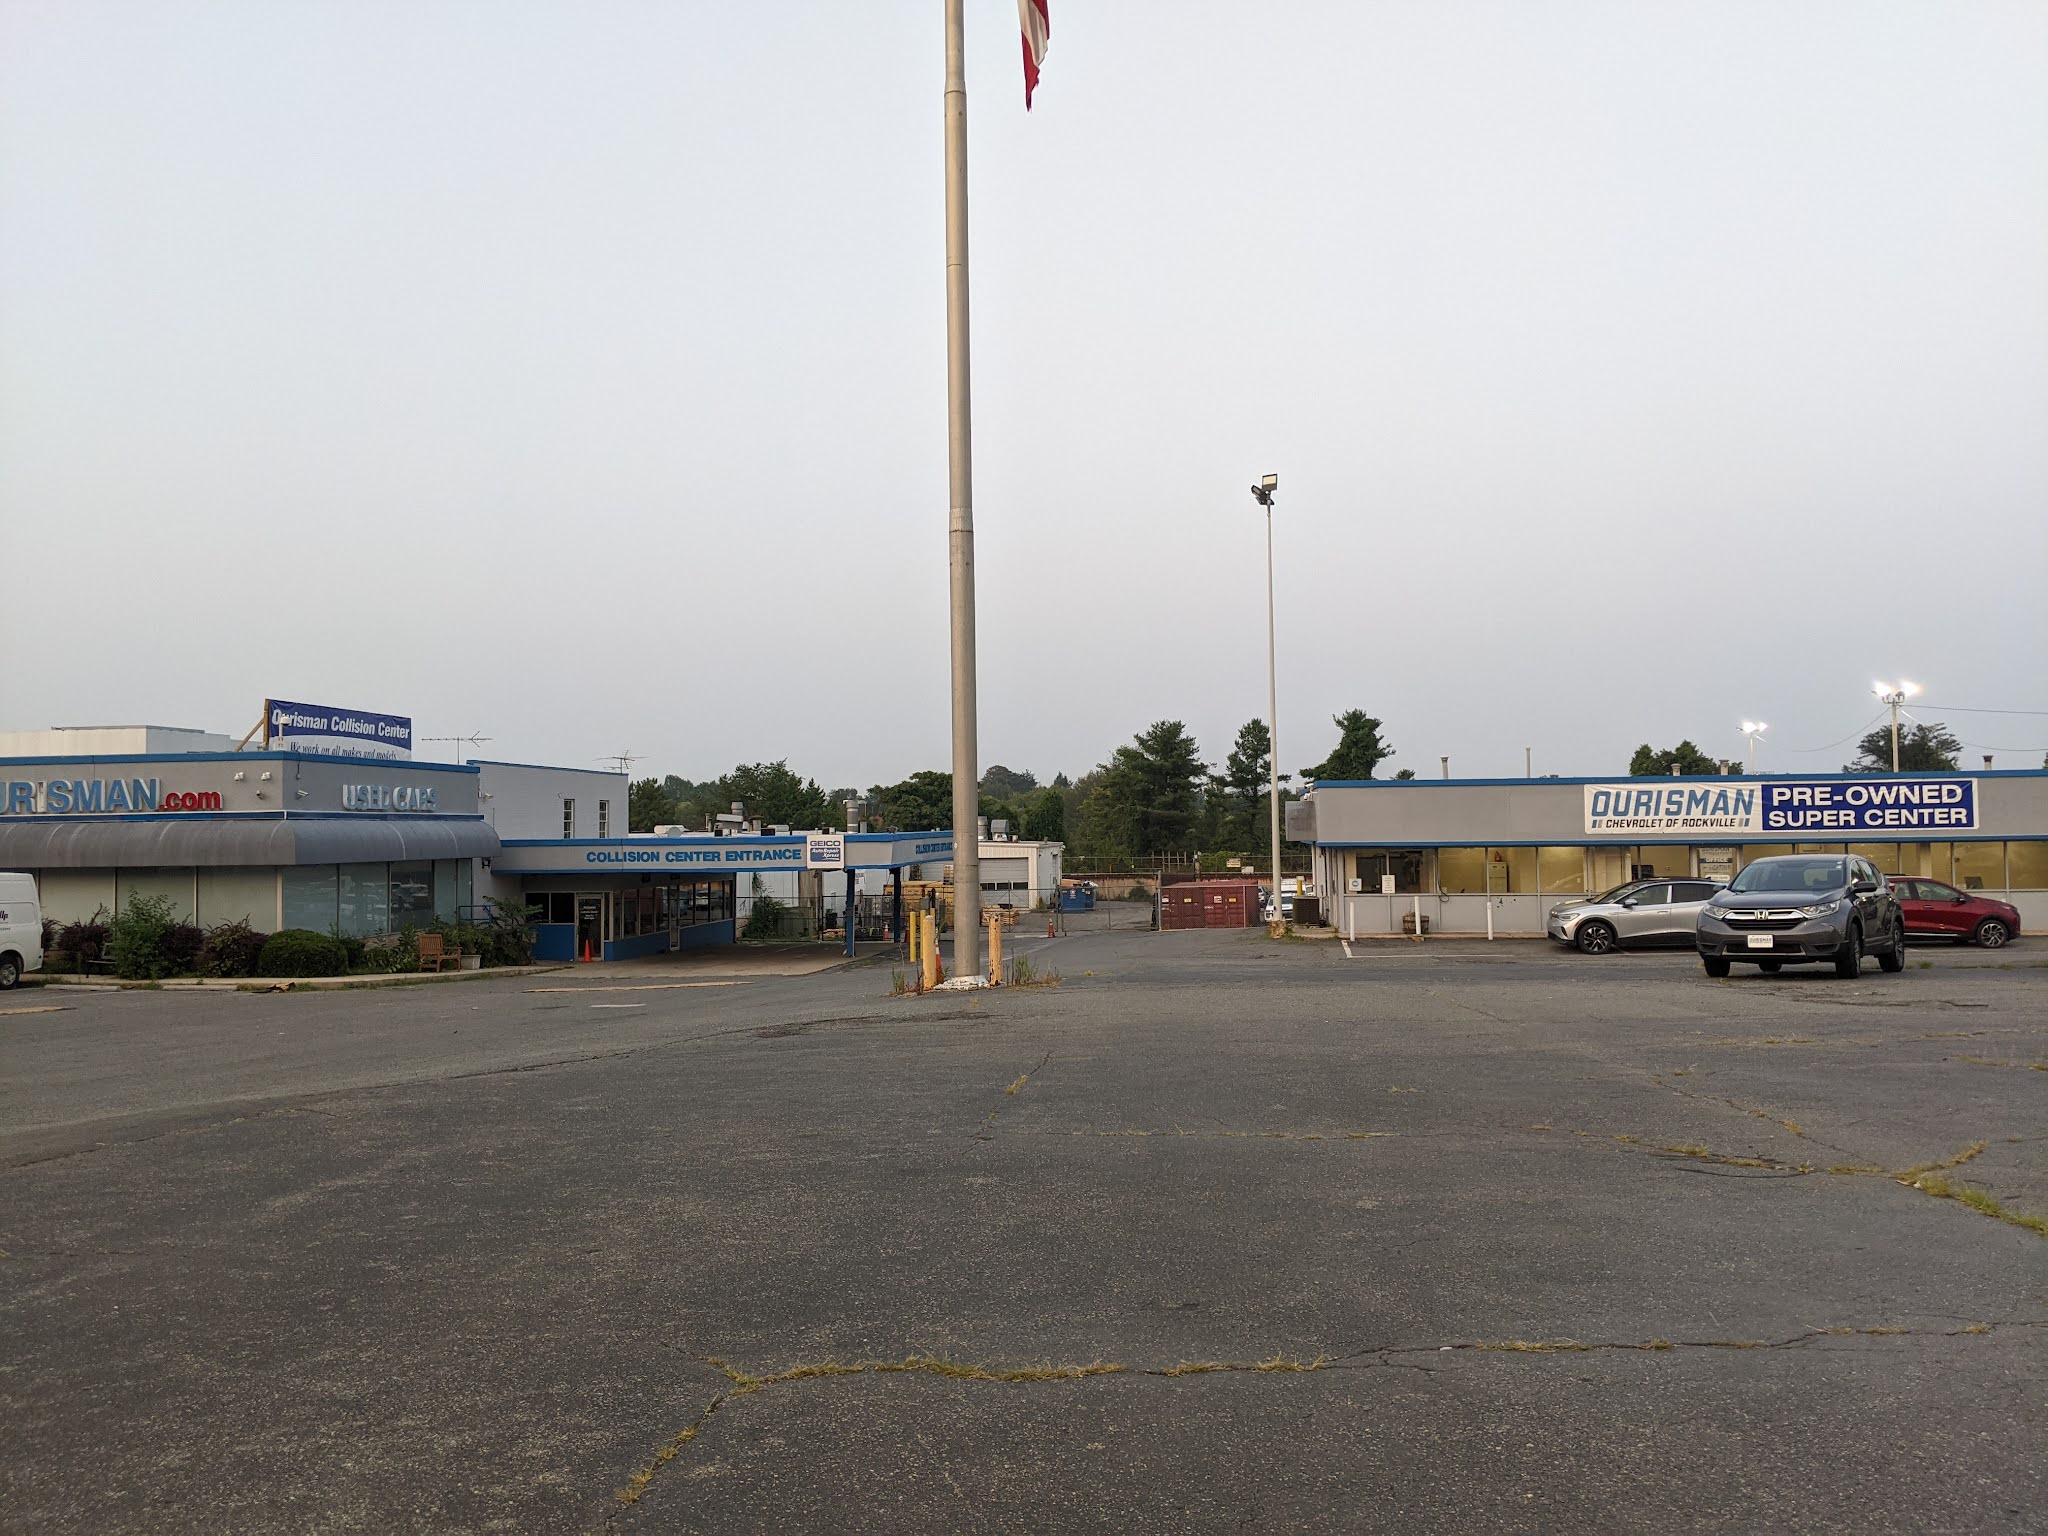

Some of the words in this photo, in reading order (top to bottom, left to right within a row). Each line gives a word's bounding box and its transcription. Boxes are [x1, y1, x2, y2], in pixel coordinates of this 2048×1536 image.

[272, 709, 327, 730] Orisman
[331, 716, 375, 735] Collision
[378, 722, 410, 739] Center
[290, 741, 301, 752] We
[302, 744, 319, 754] work
[321, 747, 330, 755] on
[331, 745, 340, 756] all
[342, 747, 362, 757] makes
[363, 749, 375, 758] and
[342, 785, 392, 811] USED
[393, 786, 439, 811] CARS
[1591, 789, 1754, 817] OURISMAN
[1772, 784, 1963, 807] PRE-OWNED
[1606, 819, 1663, 828] CHEVROLET
[1665, 818, 1679, 828] OF
[1681, 818, 1736, 828] ROCKVILLE
[1768, 809, 1856, 827] SUPER
[1864, 807, 1968, 825] CENTER
[586, 851, 659, 863] COLLISION
[665, 851, 721, 862] CENTER
[725, 849, 802, 861] ENTRANCE
